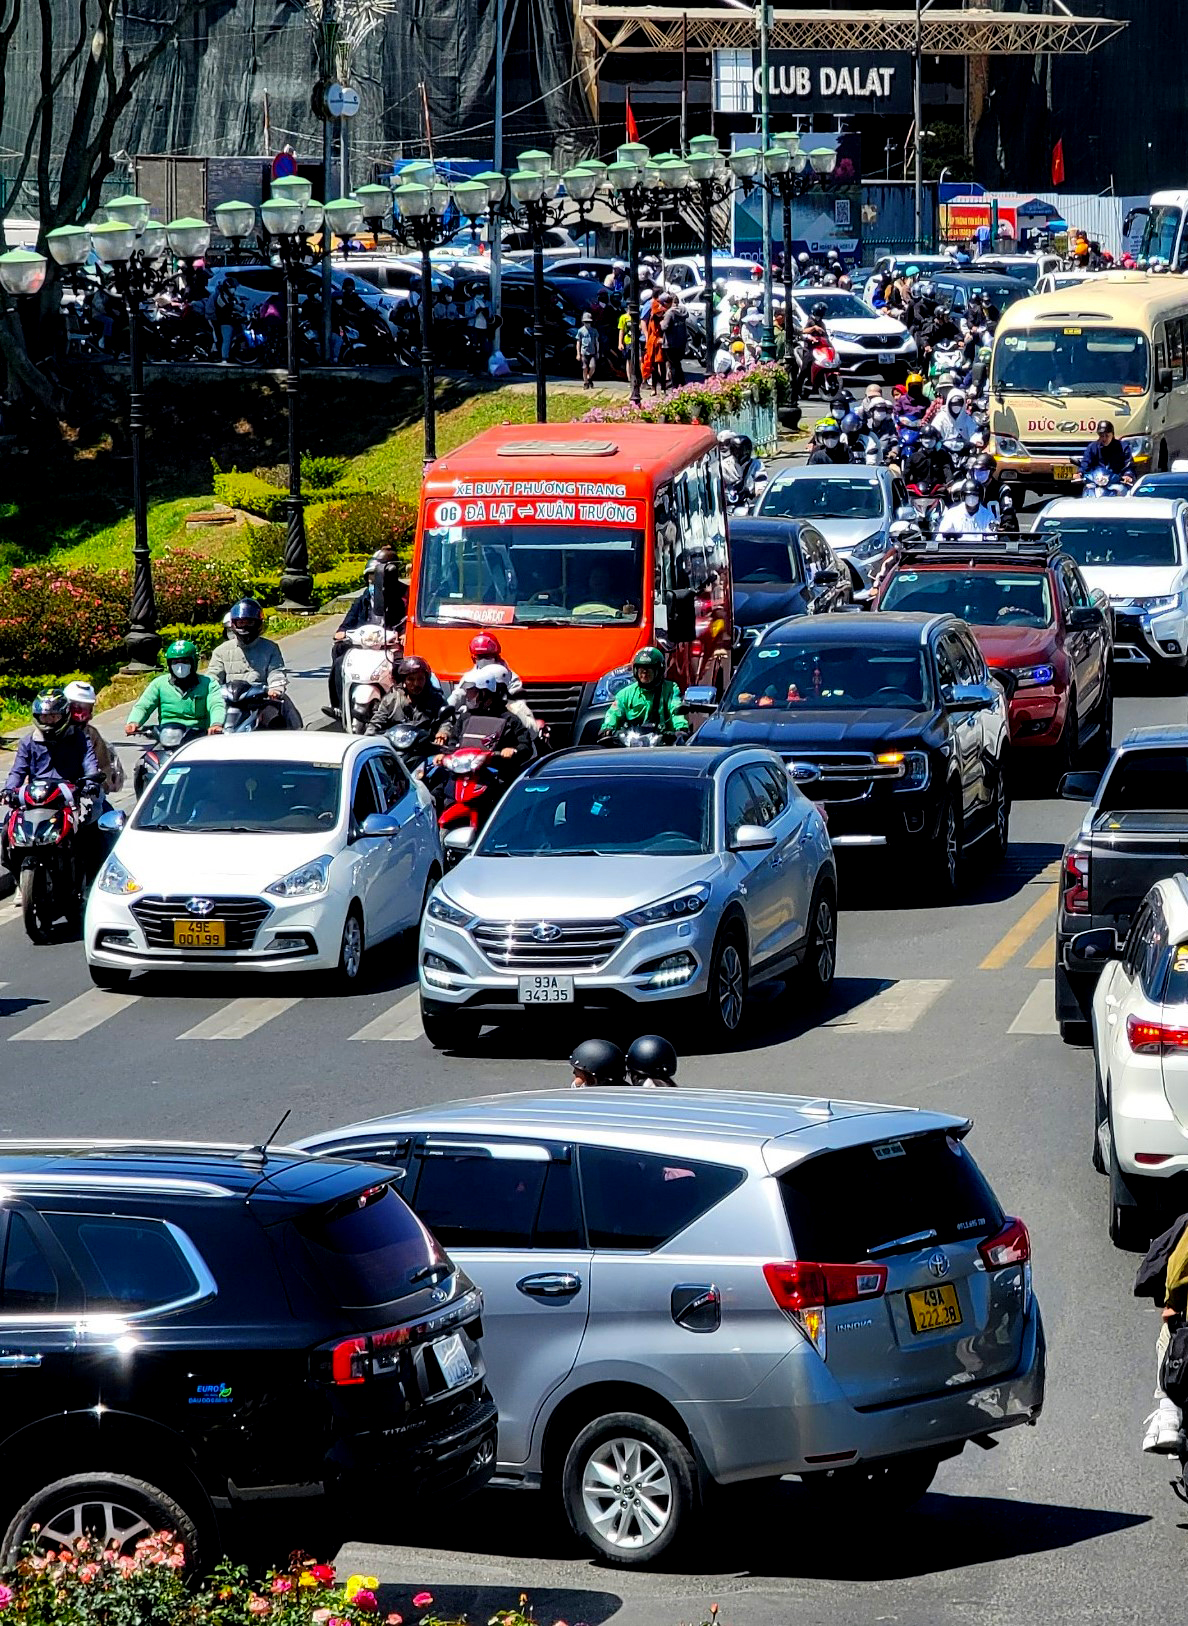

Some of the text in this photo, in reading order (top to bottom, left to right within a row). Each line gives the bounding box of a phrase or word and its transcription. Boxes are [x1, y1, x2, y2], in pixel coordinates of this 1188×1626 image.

[753, 65, 895, 97] CLUB DALAT
[1028, 415, 1098, 434] ĐỨC LỘ
[456, 479, 626, 497] XE BUÝT PHƯƠNG TRANG
[440, 506, 458, 522] 06
[466, 500, 637, 523] ĐÀ LẠT XUÂN TRƯỜNG
[188, 921, 210, 932] 49E
[178, 934, 220, 945] 001.99
[535, 976, 558, 988] 93A
[525, 990, 569, 1002] 343.35
[923, 1289, 945, 1308] 49A
[835, 1319, 872, 1332] INNOVA
